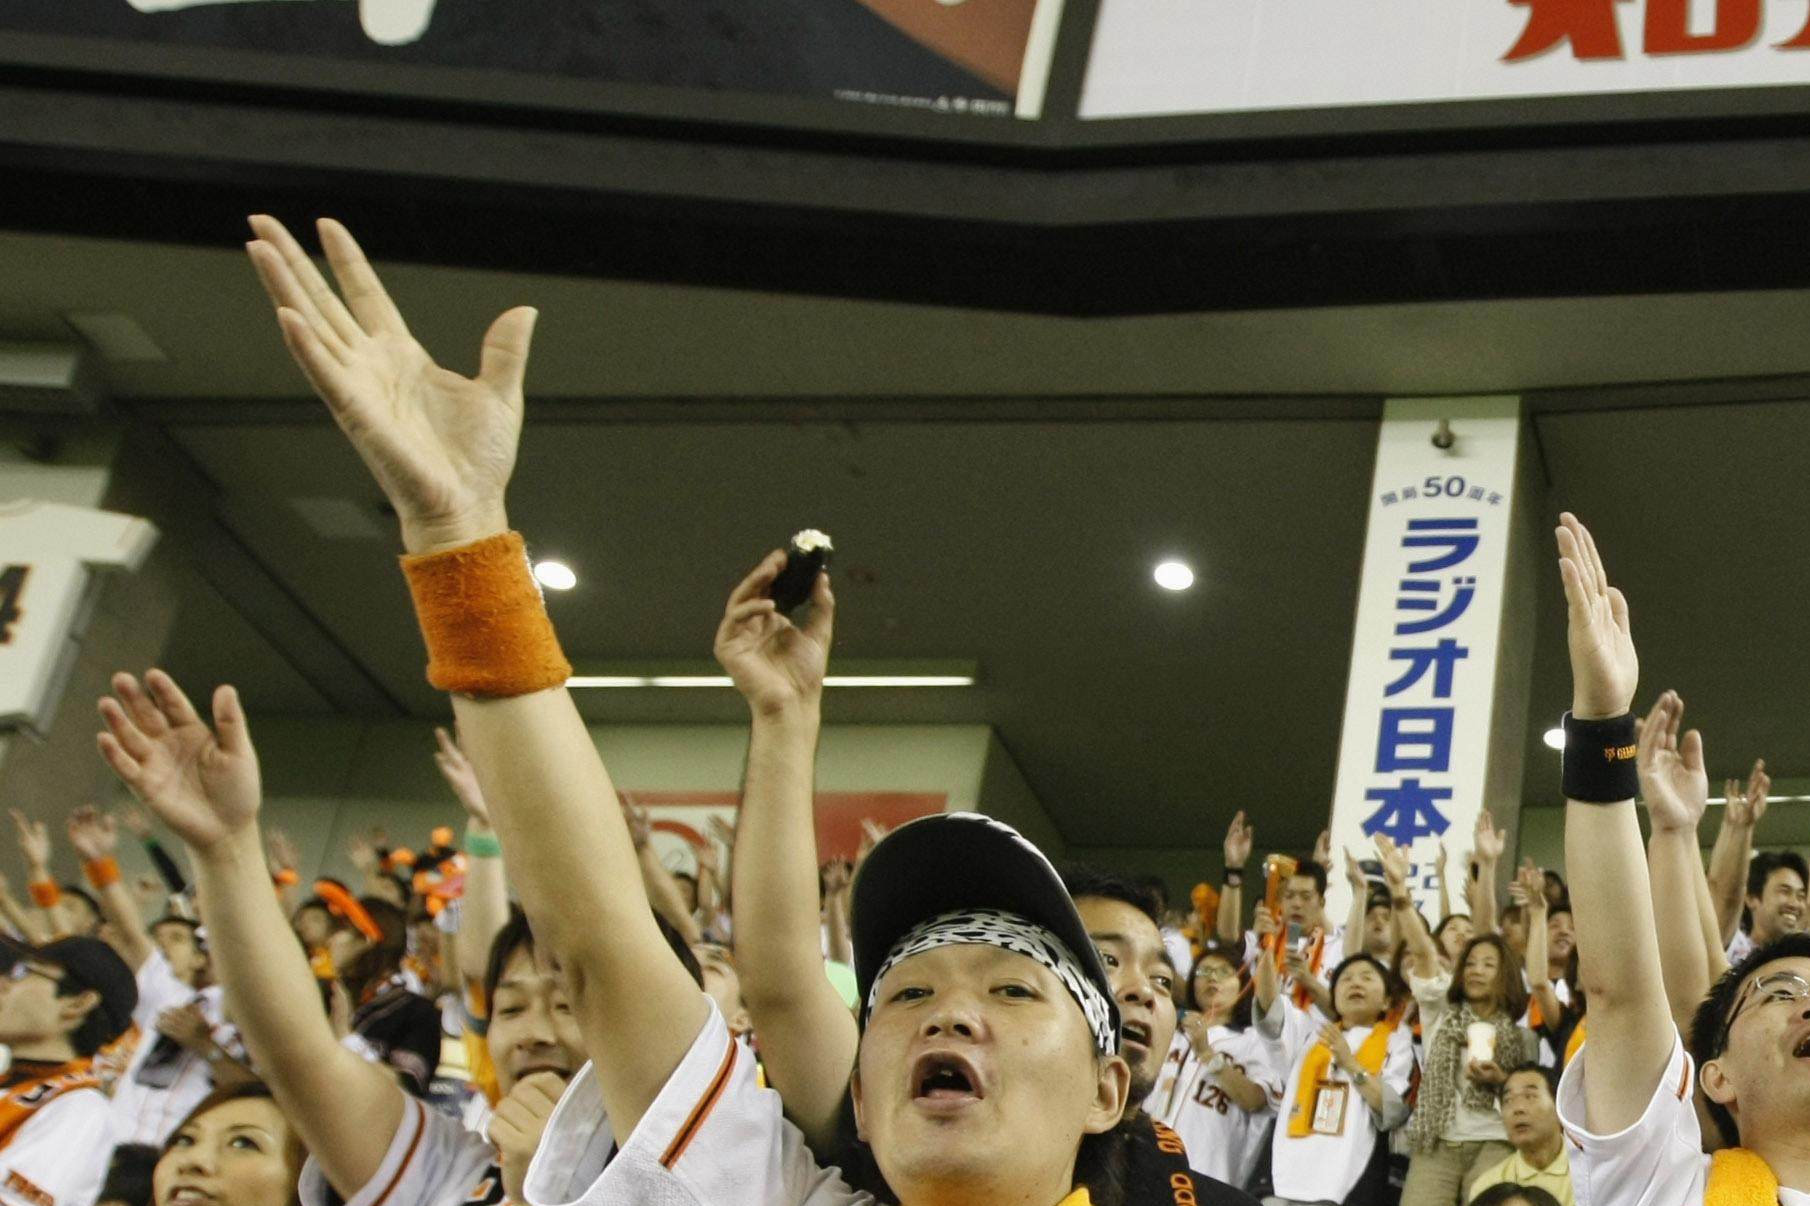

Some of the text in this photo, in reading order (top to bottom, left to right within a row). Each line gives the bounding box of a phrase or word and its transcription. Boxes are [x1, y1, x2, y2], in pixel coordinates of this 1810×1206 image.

[1360, 518, 1481, 848] ラジオ日本
